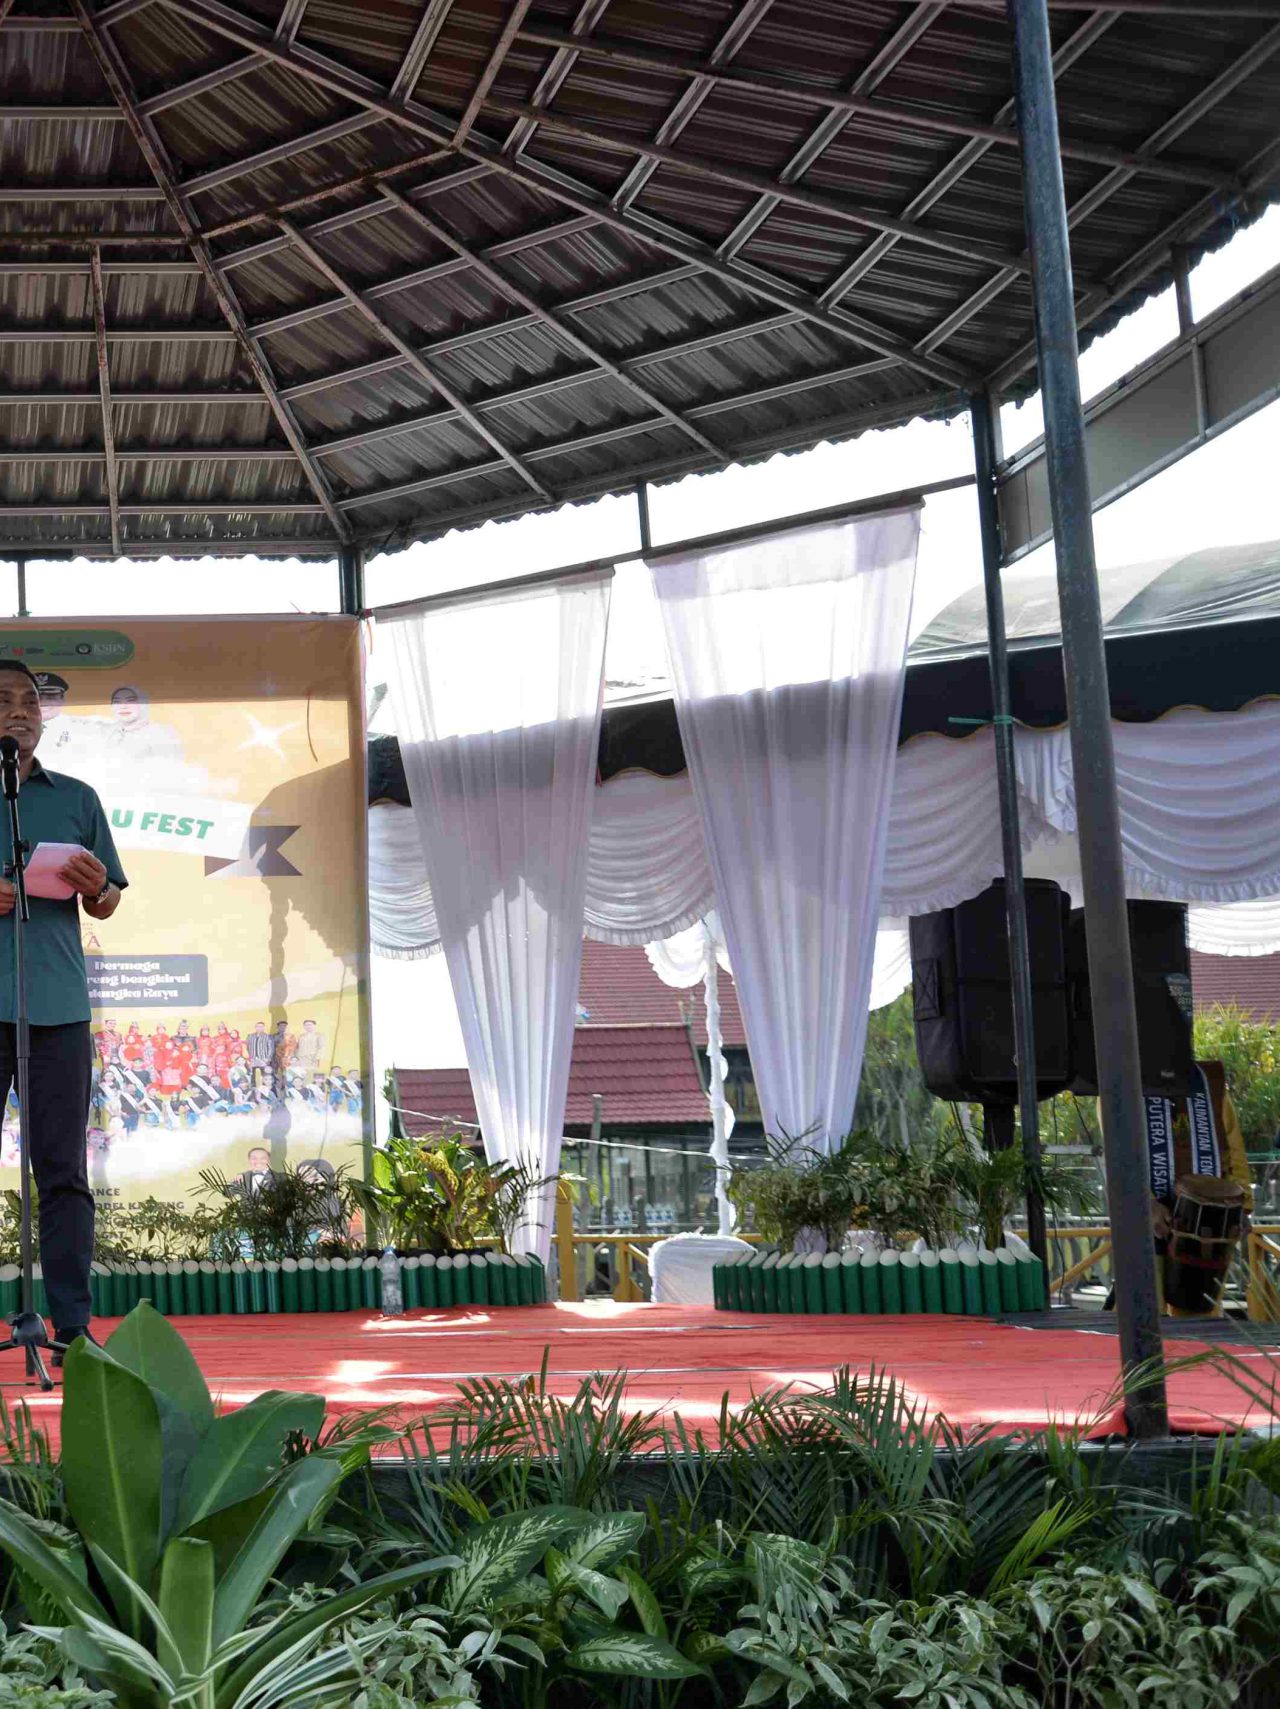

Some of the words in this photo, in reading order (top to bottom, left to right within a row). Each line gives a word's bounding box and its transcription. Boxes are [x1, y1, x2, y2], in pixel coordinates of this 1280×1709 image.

[111, 808, 135, 828] U
[140, 812, 214, 839] FEST
[95, 962, 160, 973] Dermaga
[86, 975, 119, 986] reng
[143, 988, 179, 1000] Raya
[1148, 1097, 1165, 1146] PUTERA
[1195, 1092, 1211, 1151] KALIMANTAN
[90, 1188, 121, 1197] ANCE
[95, 1202, 126, 1210] ODEL
